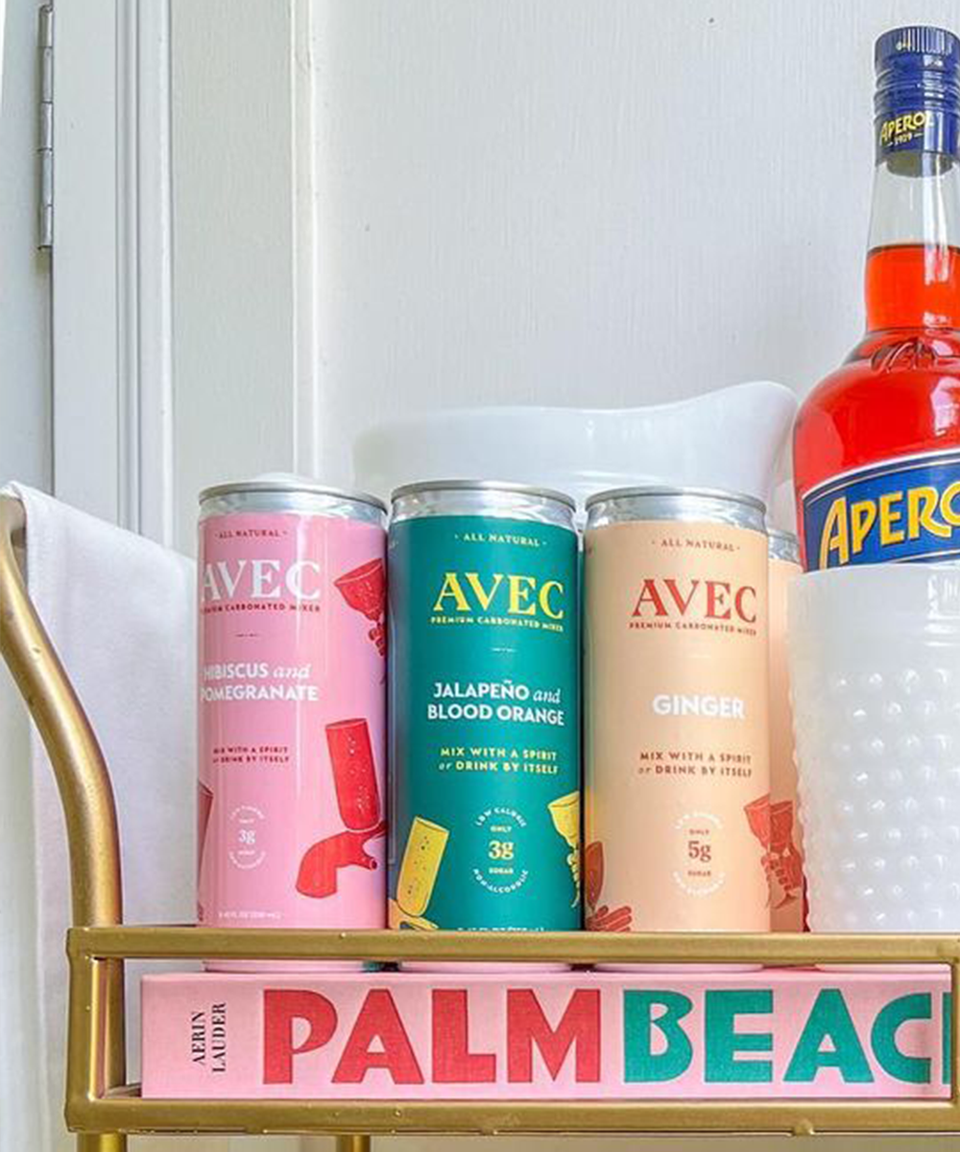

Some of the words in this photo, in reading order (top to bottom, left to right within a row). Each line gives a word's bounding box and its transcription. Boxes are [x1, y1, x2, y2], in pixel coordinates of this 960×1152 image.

[236, 529, 280, 538] NATURAL
[463, 533, 485, 543] ALL
[489, 534, 540, 547] NATURAL
[660, 539, 682, 548] ALL
[686, 539, 735, 552] NATURAL
[200, 558, 321, 603] AVEC
[433, 572, 564, 620] AVEC
[631, 578, 757, 624] AVEC
[225, 603, 285, 612] CARBONATED
[431, 616, 474, 625] PREMIUM
[477, 616, 540, 629] CARBONATED
[628, 621, 672, 630] PREMIUM
[675, 622, 735, 633] CARBONATED
[203, 663, 268, 680] HIBISCUS
[273, 662, 311, 679] and
[200, 685, 319, 702] POMEGRANATE
[433, 679, 530, 701] JALAPEÑO
[532, 689, 561, 705] and
[427, 704, 493, 720] BLOOD
[496, 705, 565, 726] ORANGE
[652, 694, 746, 719] GINGER
[440, 747, 465, 757] MIX
[470, 748, 506, 758] WITH
[510, 749, 519, 758] A
[522, 750, 557, 761] SPIRIT
[640, 751, 664, 761] MIX
[669, 751, 704, 762] WITH
[708, 753, 715, 762] A
[720, 753, 752, 764] SPIRIT
[438, 762, 452, 771] or
[455, 761, 498, 772] DRINK
[503, 762, 519, 772] BY
[523, 763, 558, 775] ITSELF
[638, 767, 651, 775] or
[655, 765, 696, 775] DRINK
[701, 766, 716, 775] BY
[720, 767, 752, 778] ITSELF
[488, 839, 515, 860] 3g
[687, 840, 712, 862] 5g
[191, 1010, 206, 1066] AERIN
[211, 1002, 226, 1074] LAUDER
[263, 988, 601, 1085] PALM
